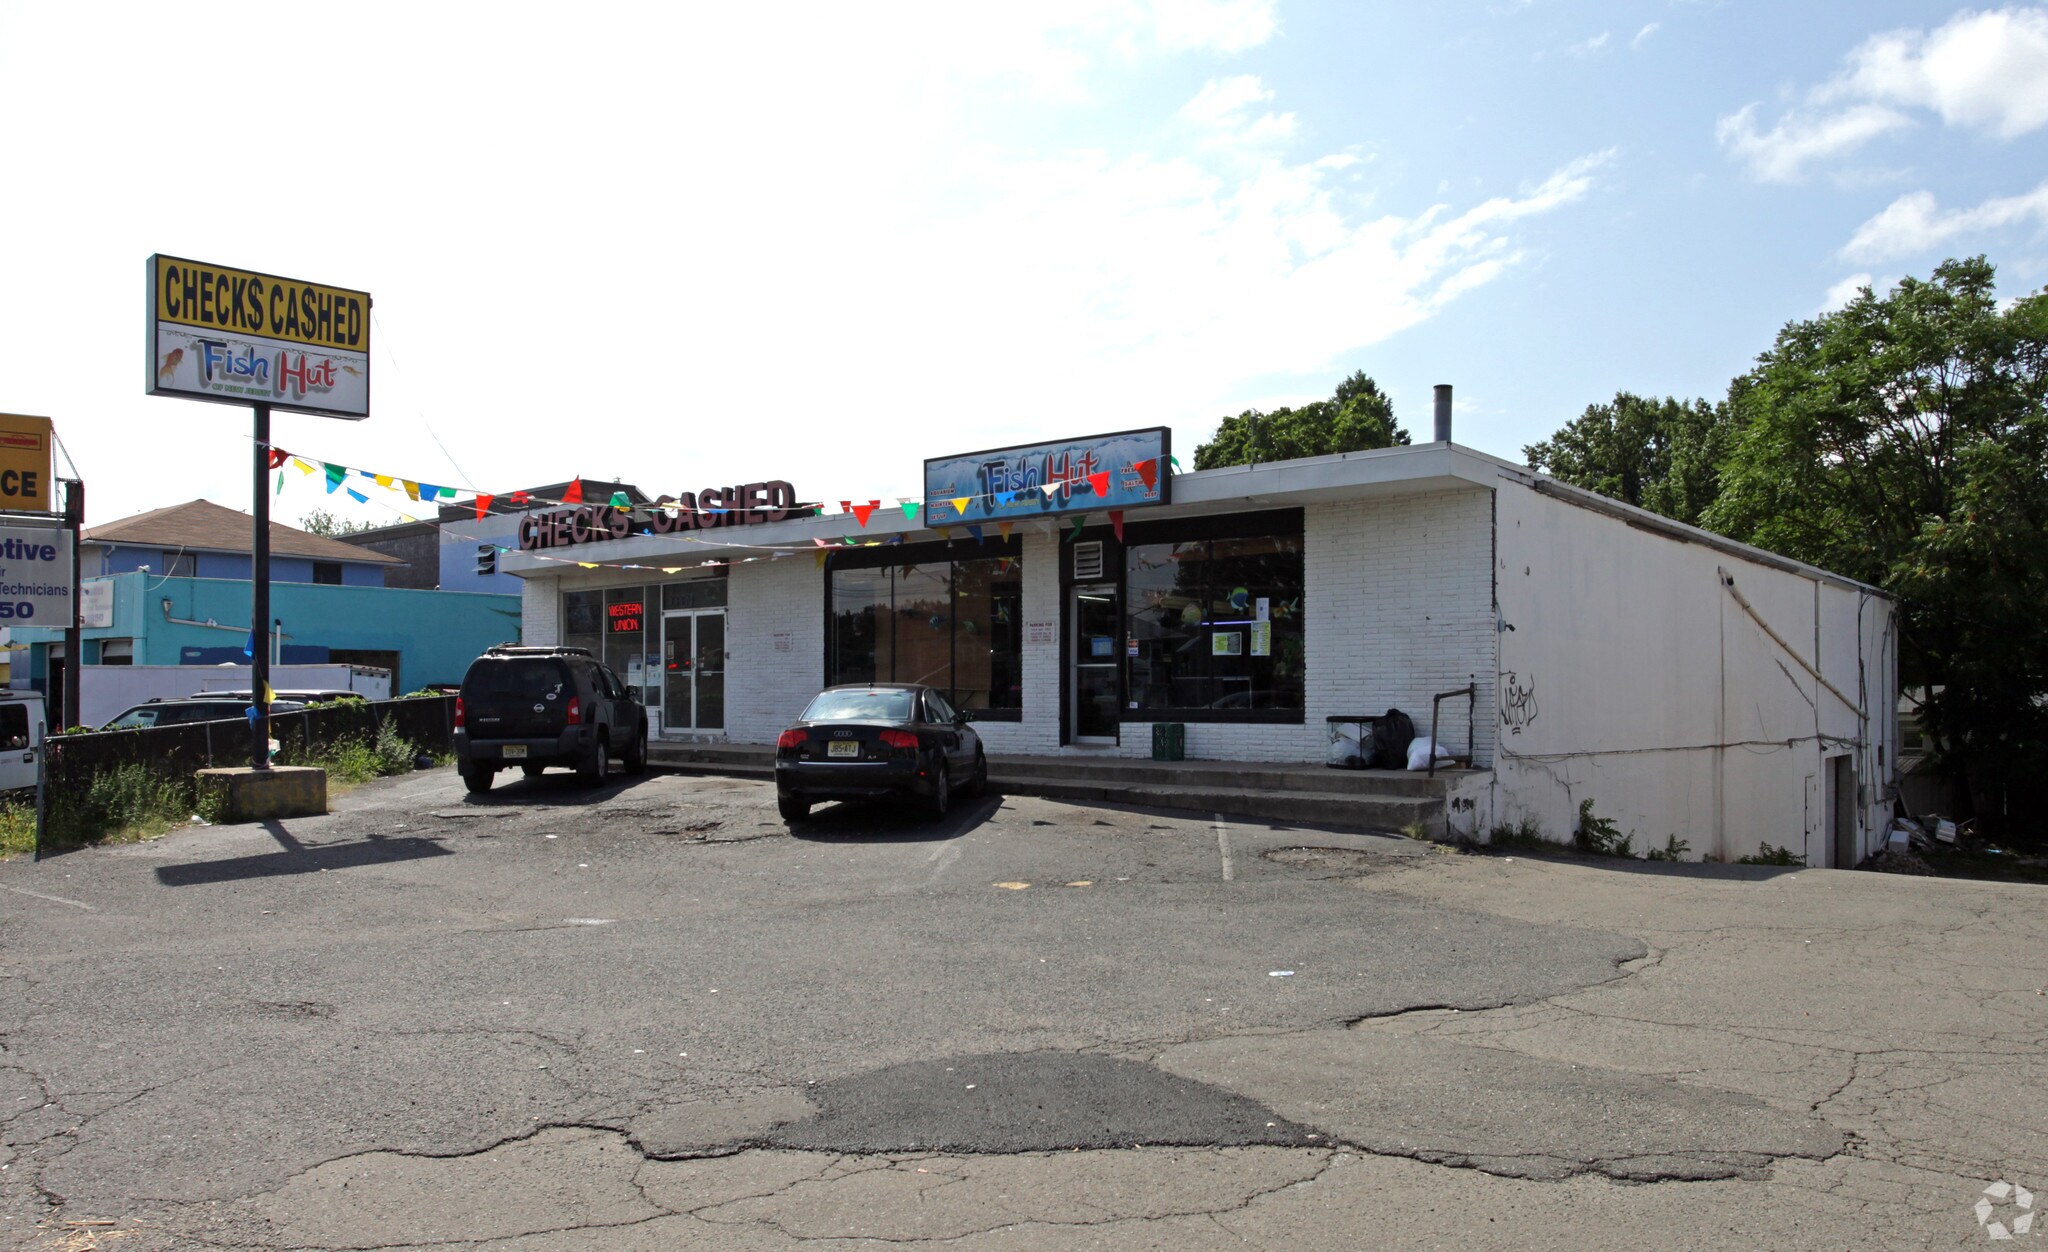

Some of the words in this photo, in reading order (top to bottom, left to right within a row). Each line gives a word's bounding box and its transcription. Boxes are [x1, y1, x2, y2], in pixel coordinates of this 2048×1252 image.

[197, 339, 269, 381] Fish
[279, 351, 338, 394] Hut
[224, 384, 245, 394] NEW
[982, 458, 1038, 507] Fish
[1045, 450, 1098, 499] Hut
[930, 488, 955, 496] AQUARIUM
[518, 504, 632, 550] CHECKS
[651, 480, 797, 534] CASHED
[0, 537, 57, 562] tive
[0, 582, 68, 596] Technicians
[608, 603, 642, 617] WESTERN
[613, 618, 639, 632] UNION
